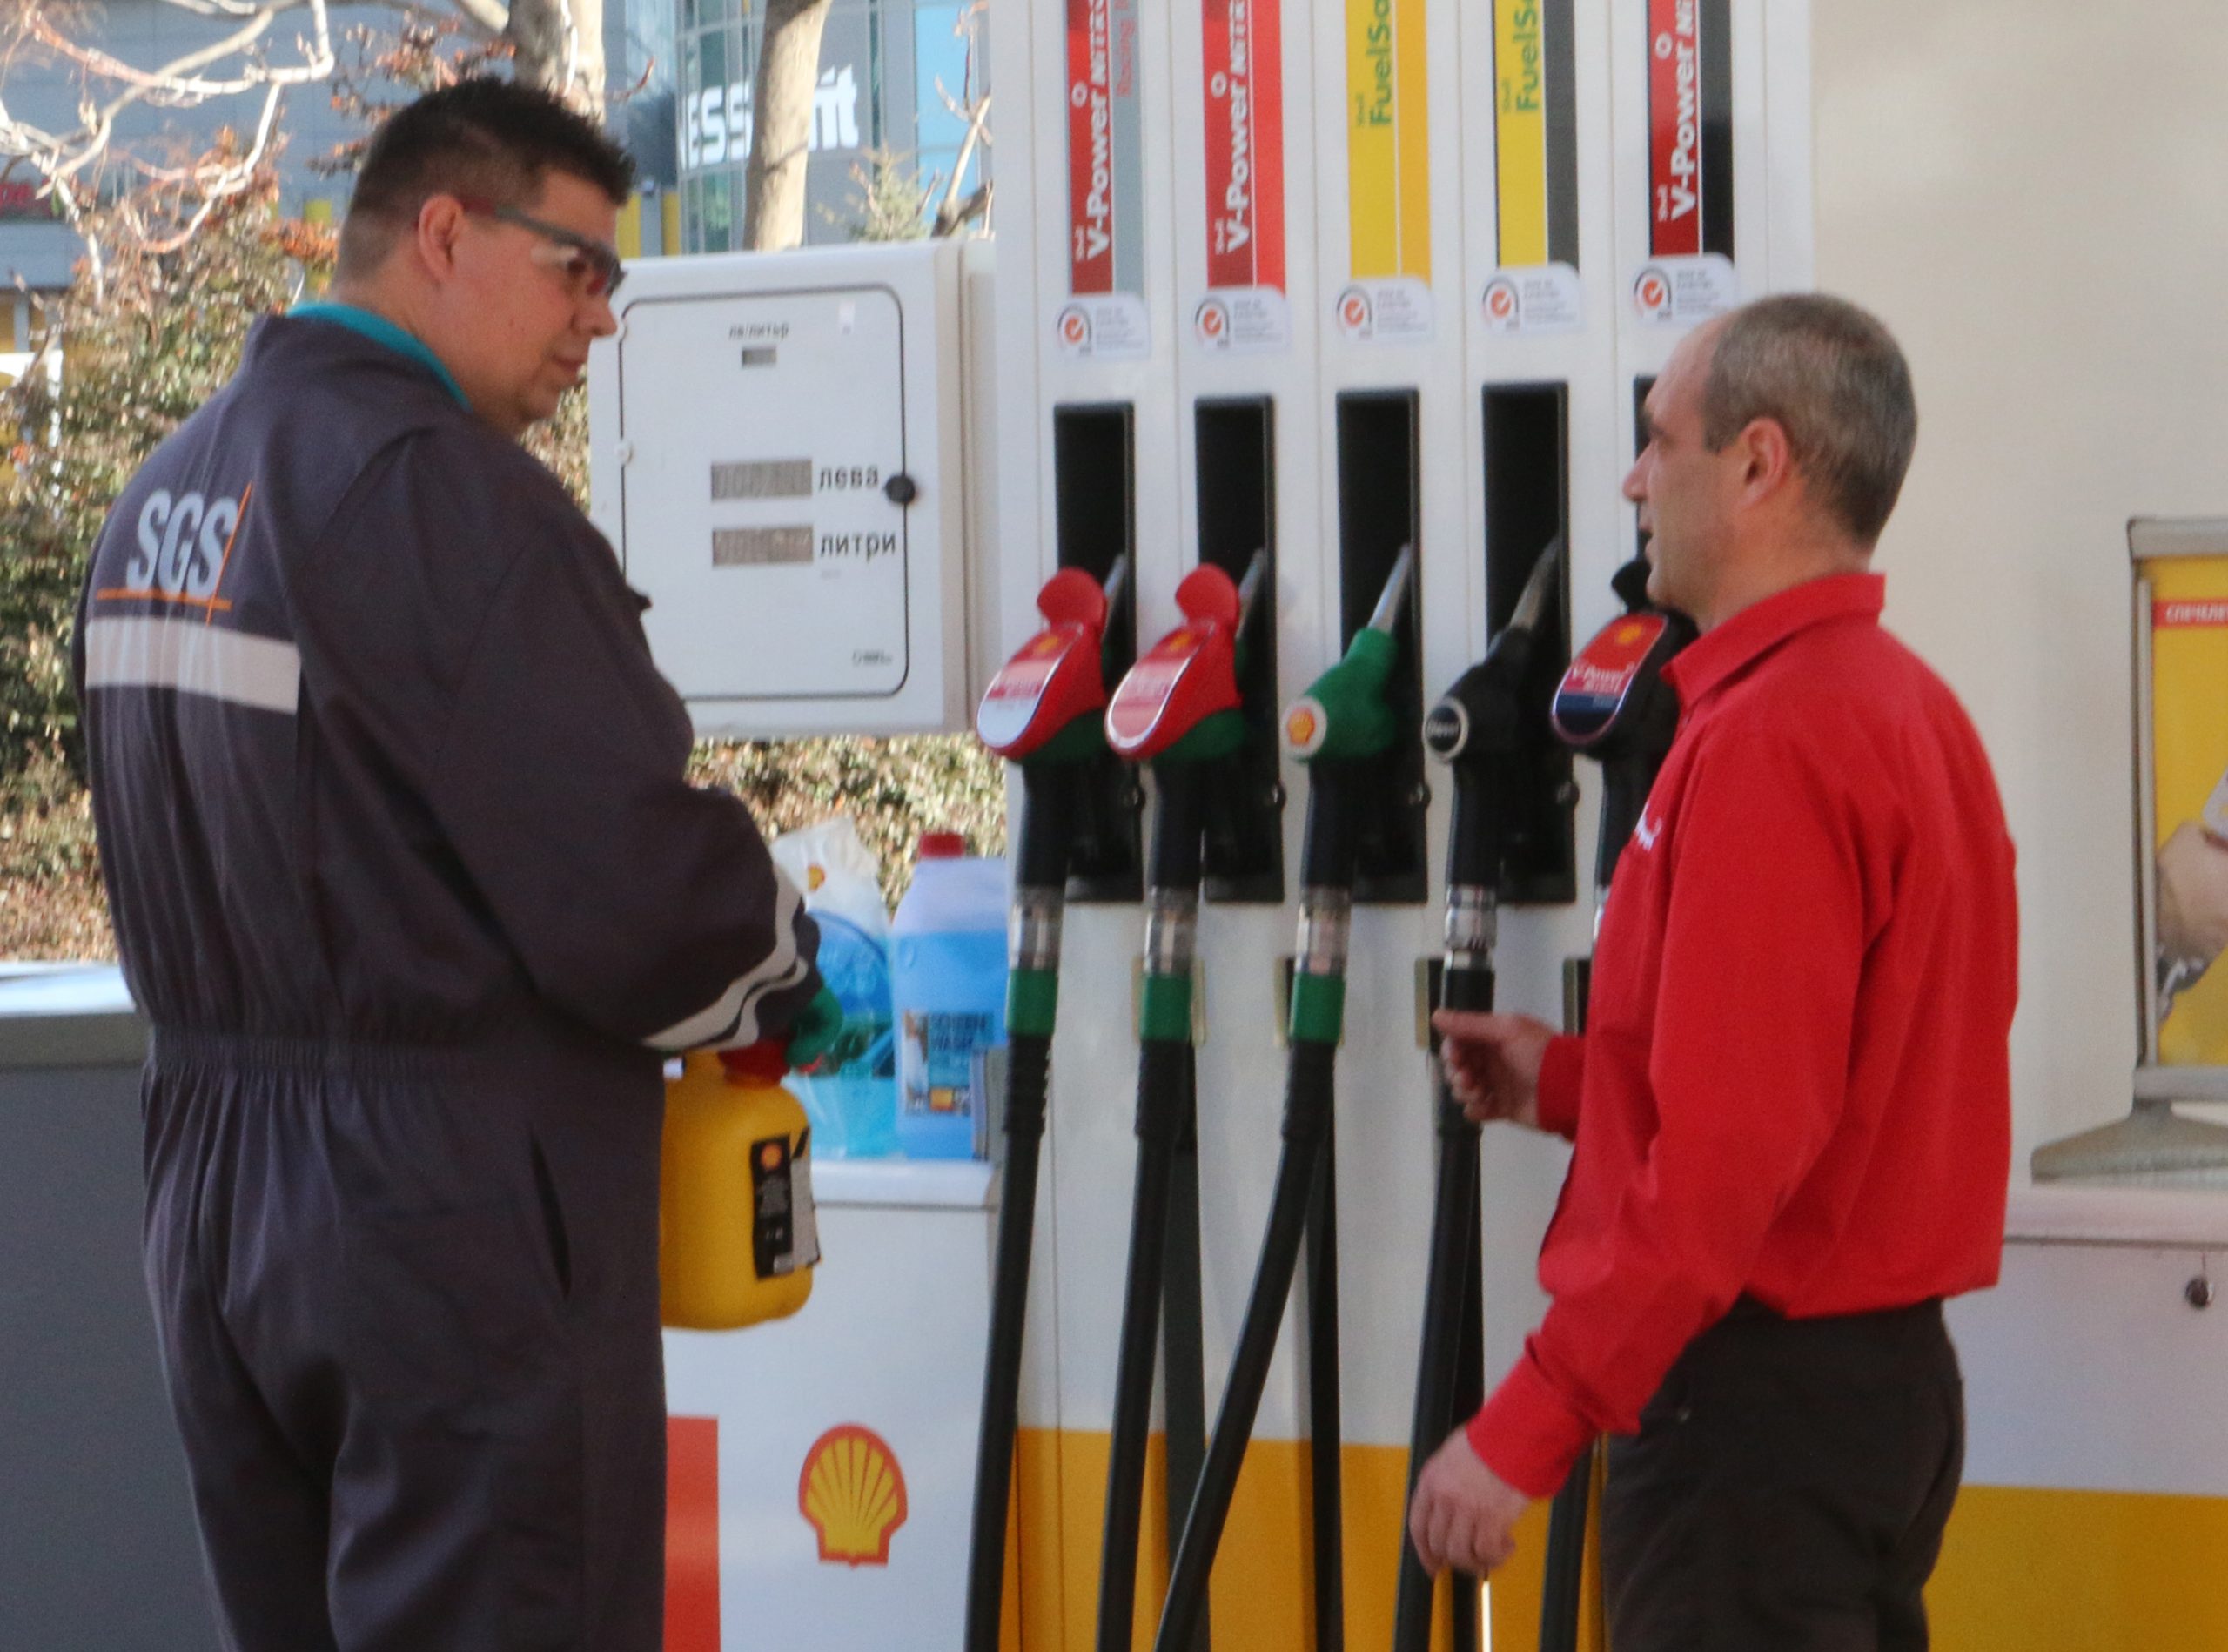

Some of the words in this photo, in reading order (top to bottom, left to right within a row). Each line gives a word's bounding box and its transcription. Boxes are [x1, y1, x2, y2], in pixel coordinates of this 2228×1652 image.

[1086, 91, 1111, 259] V-Power
[1225, 82, 1250, 252] V-Power
[1671, 41, 1695, 221] V-Power
[126, 489, 238, 598] SGS
[819, 464, 879, 489] лева
[820, 532, 896, 562] литри
